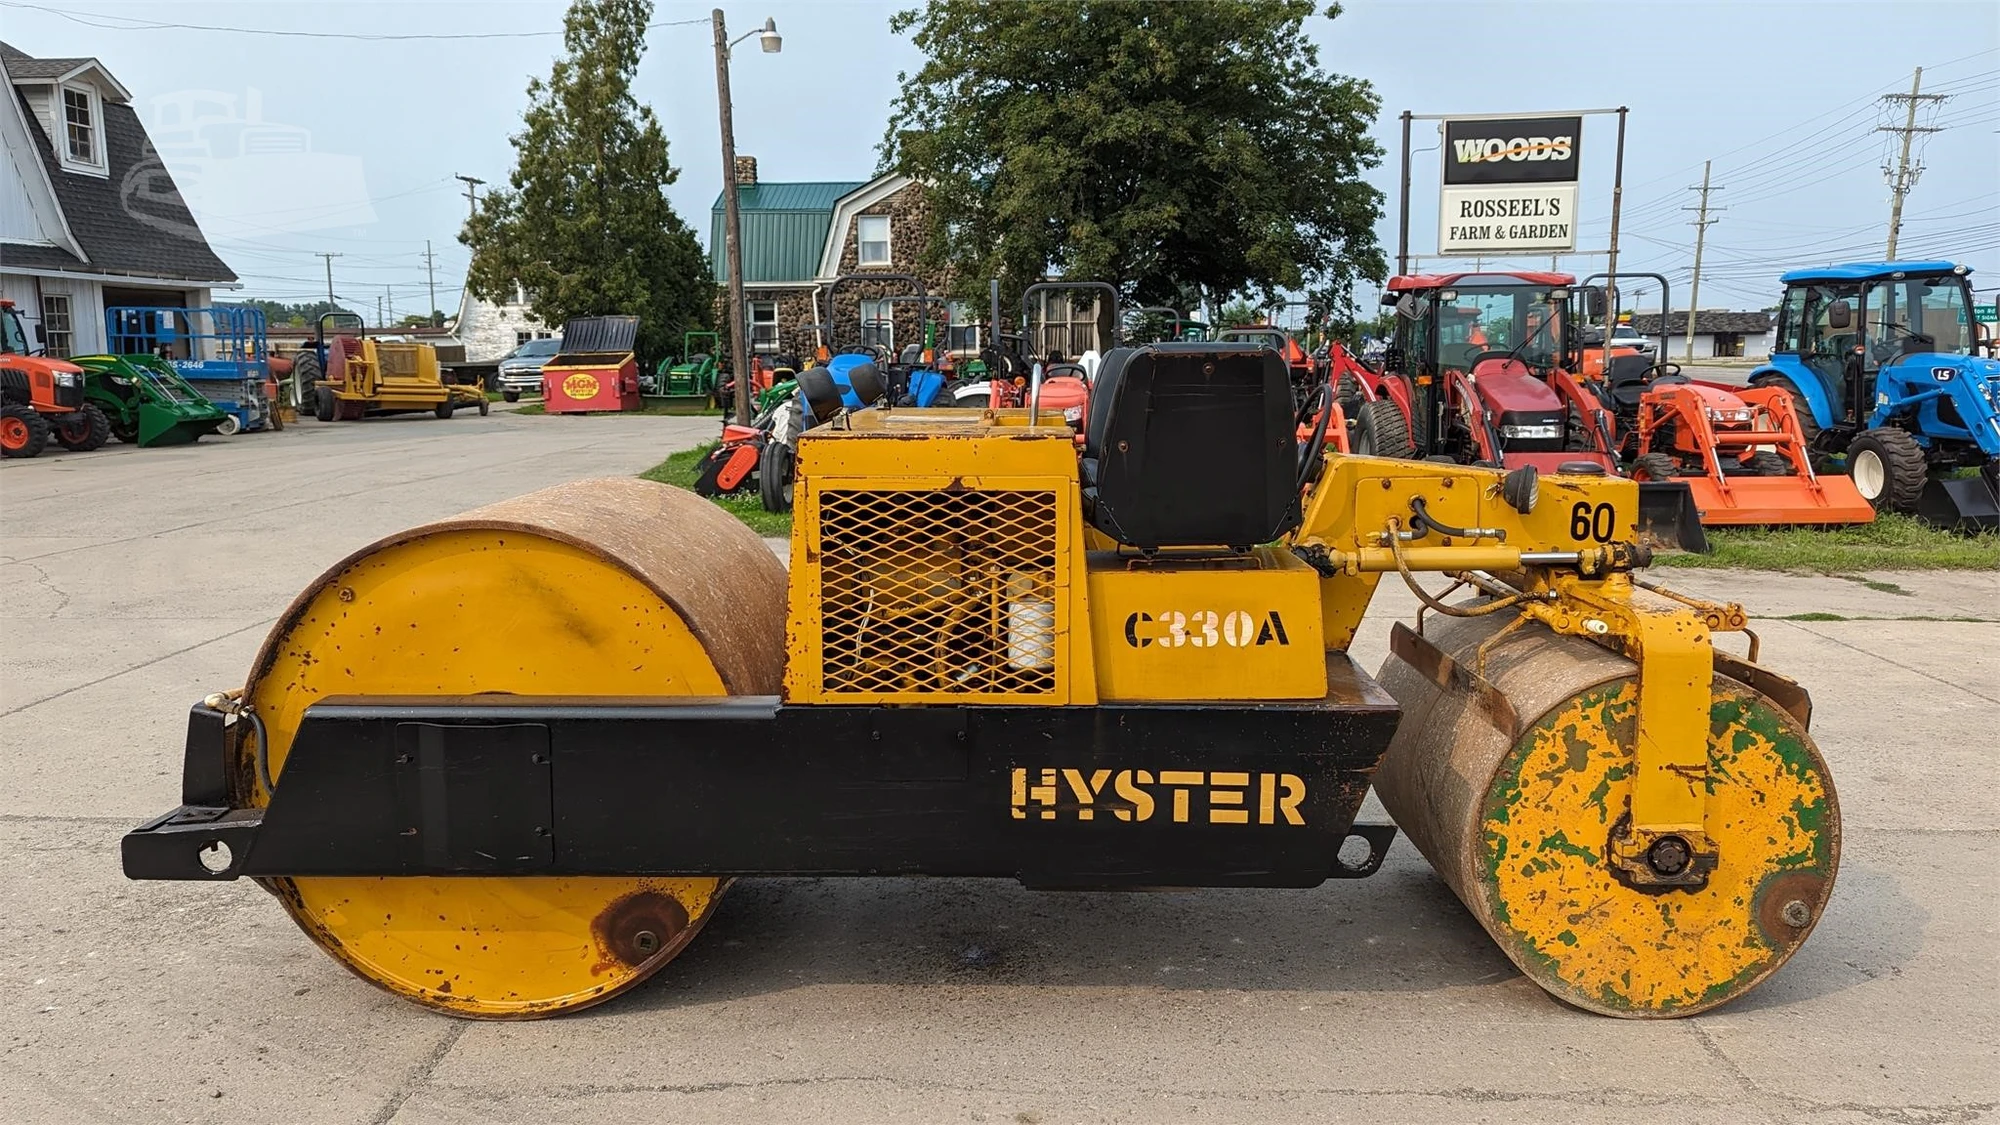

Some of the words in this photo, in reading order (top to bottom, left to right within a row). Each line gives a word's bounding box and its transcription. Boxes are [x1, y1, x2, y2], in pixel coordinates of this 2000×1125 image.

[1453, 136, 1572, 163] WOODS
[1460, 197, 1560, 218] ROSSEEL'S
[1450, 225, 1491, 240] FARM
[1494, 224, 1506, 239] &
[1509, 223, 1569, 239] GARDEN
[1937, 369, 1950, 380] LS
[1570, 501, 1615, 543] 60
[1124, 610, 1290, 648] C330A
[1011, 767, 1306, 825] HYSTER
